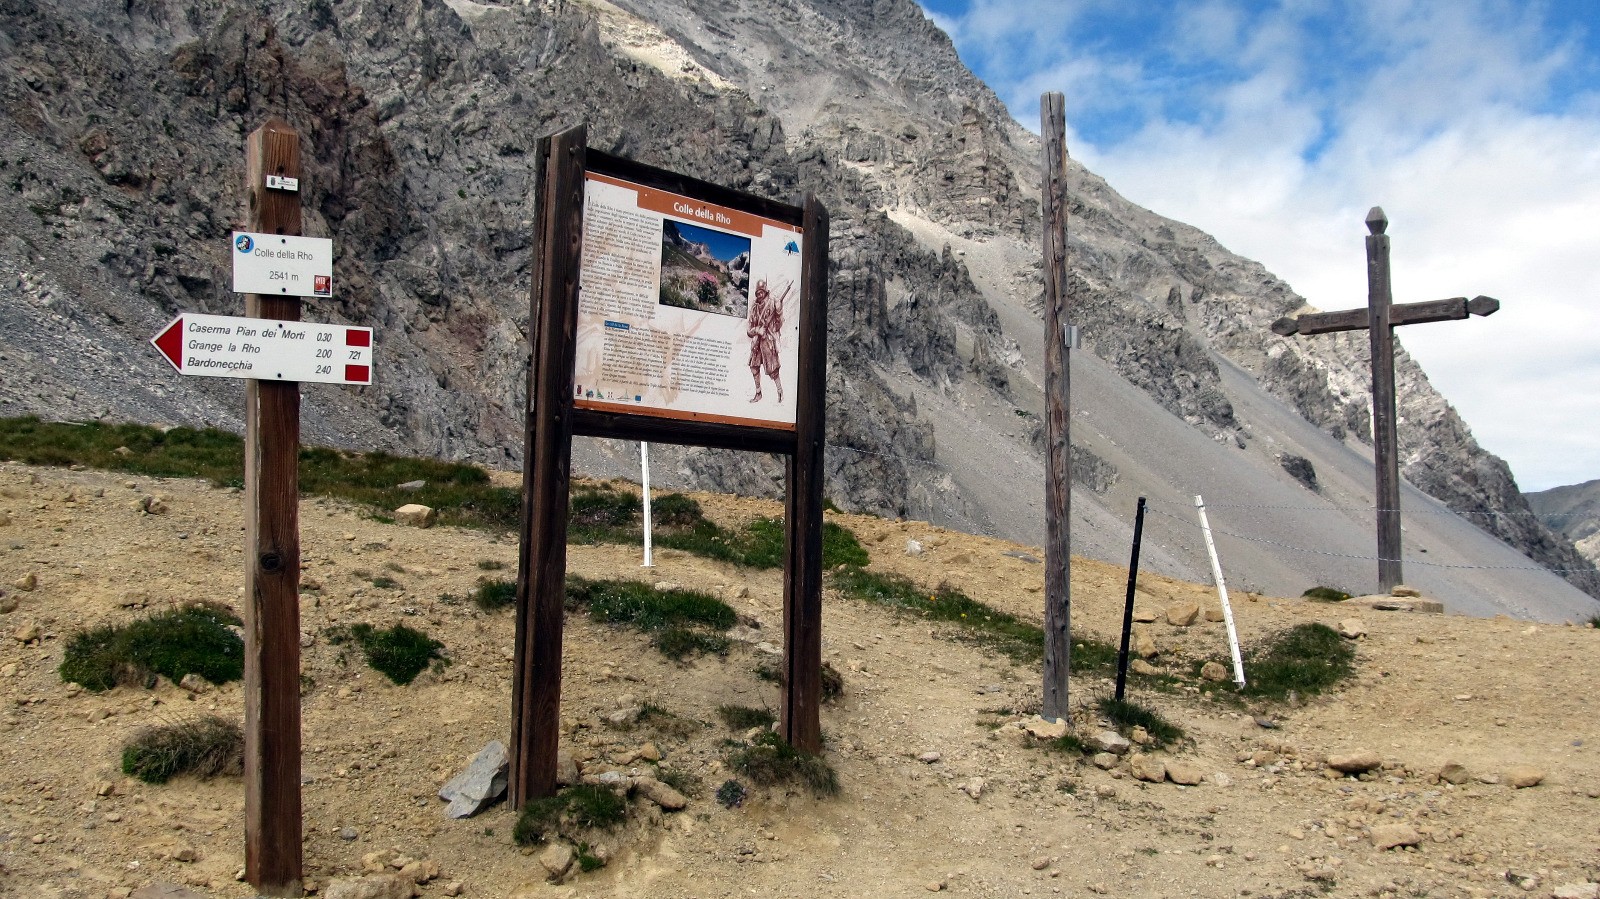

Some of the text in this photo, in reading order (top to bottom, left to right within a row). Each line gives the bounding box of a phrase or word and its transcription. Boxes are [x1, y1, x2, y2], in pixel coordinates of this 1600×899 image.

[673, 202, 731, 225] Colle della Rho
[254, 248, 313, 261] Colle della Rho
[269, 271, 299, 281] 2541 m
[188, 323, 231, 335] Caserma
[236, 327, 257, 337] Pian
[262, 328, 277, 338] dei
[281, 329, 306, 340] Morti
[188, 340, 223, 353] Grange
[228, 342, 237, 352] la
[242, 343, 261, 354] Rho
[348, 350, 361, 360] 721
[187, 357, 253, 371] Bardonecchia
